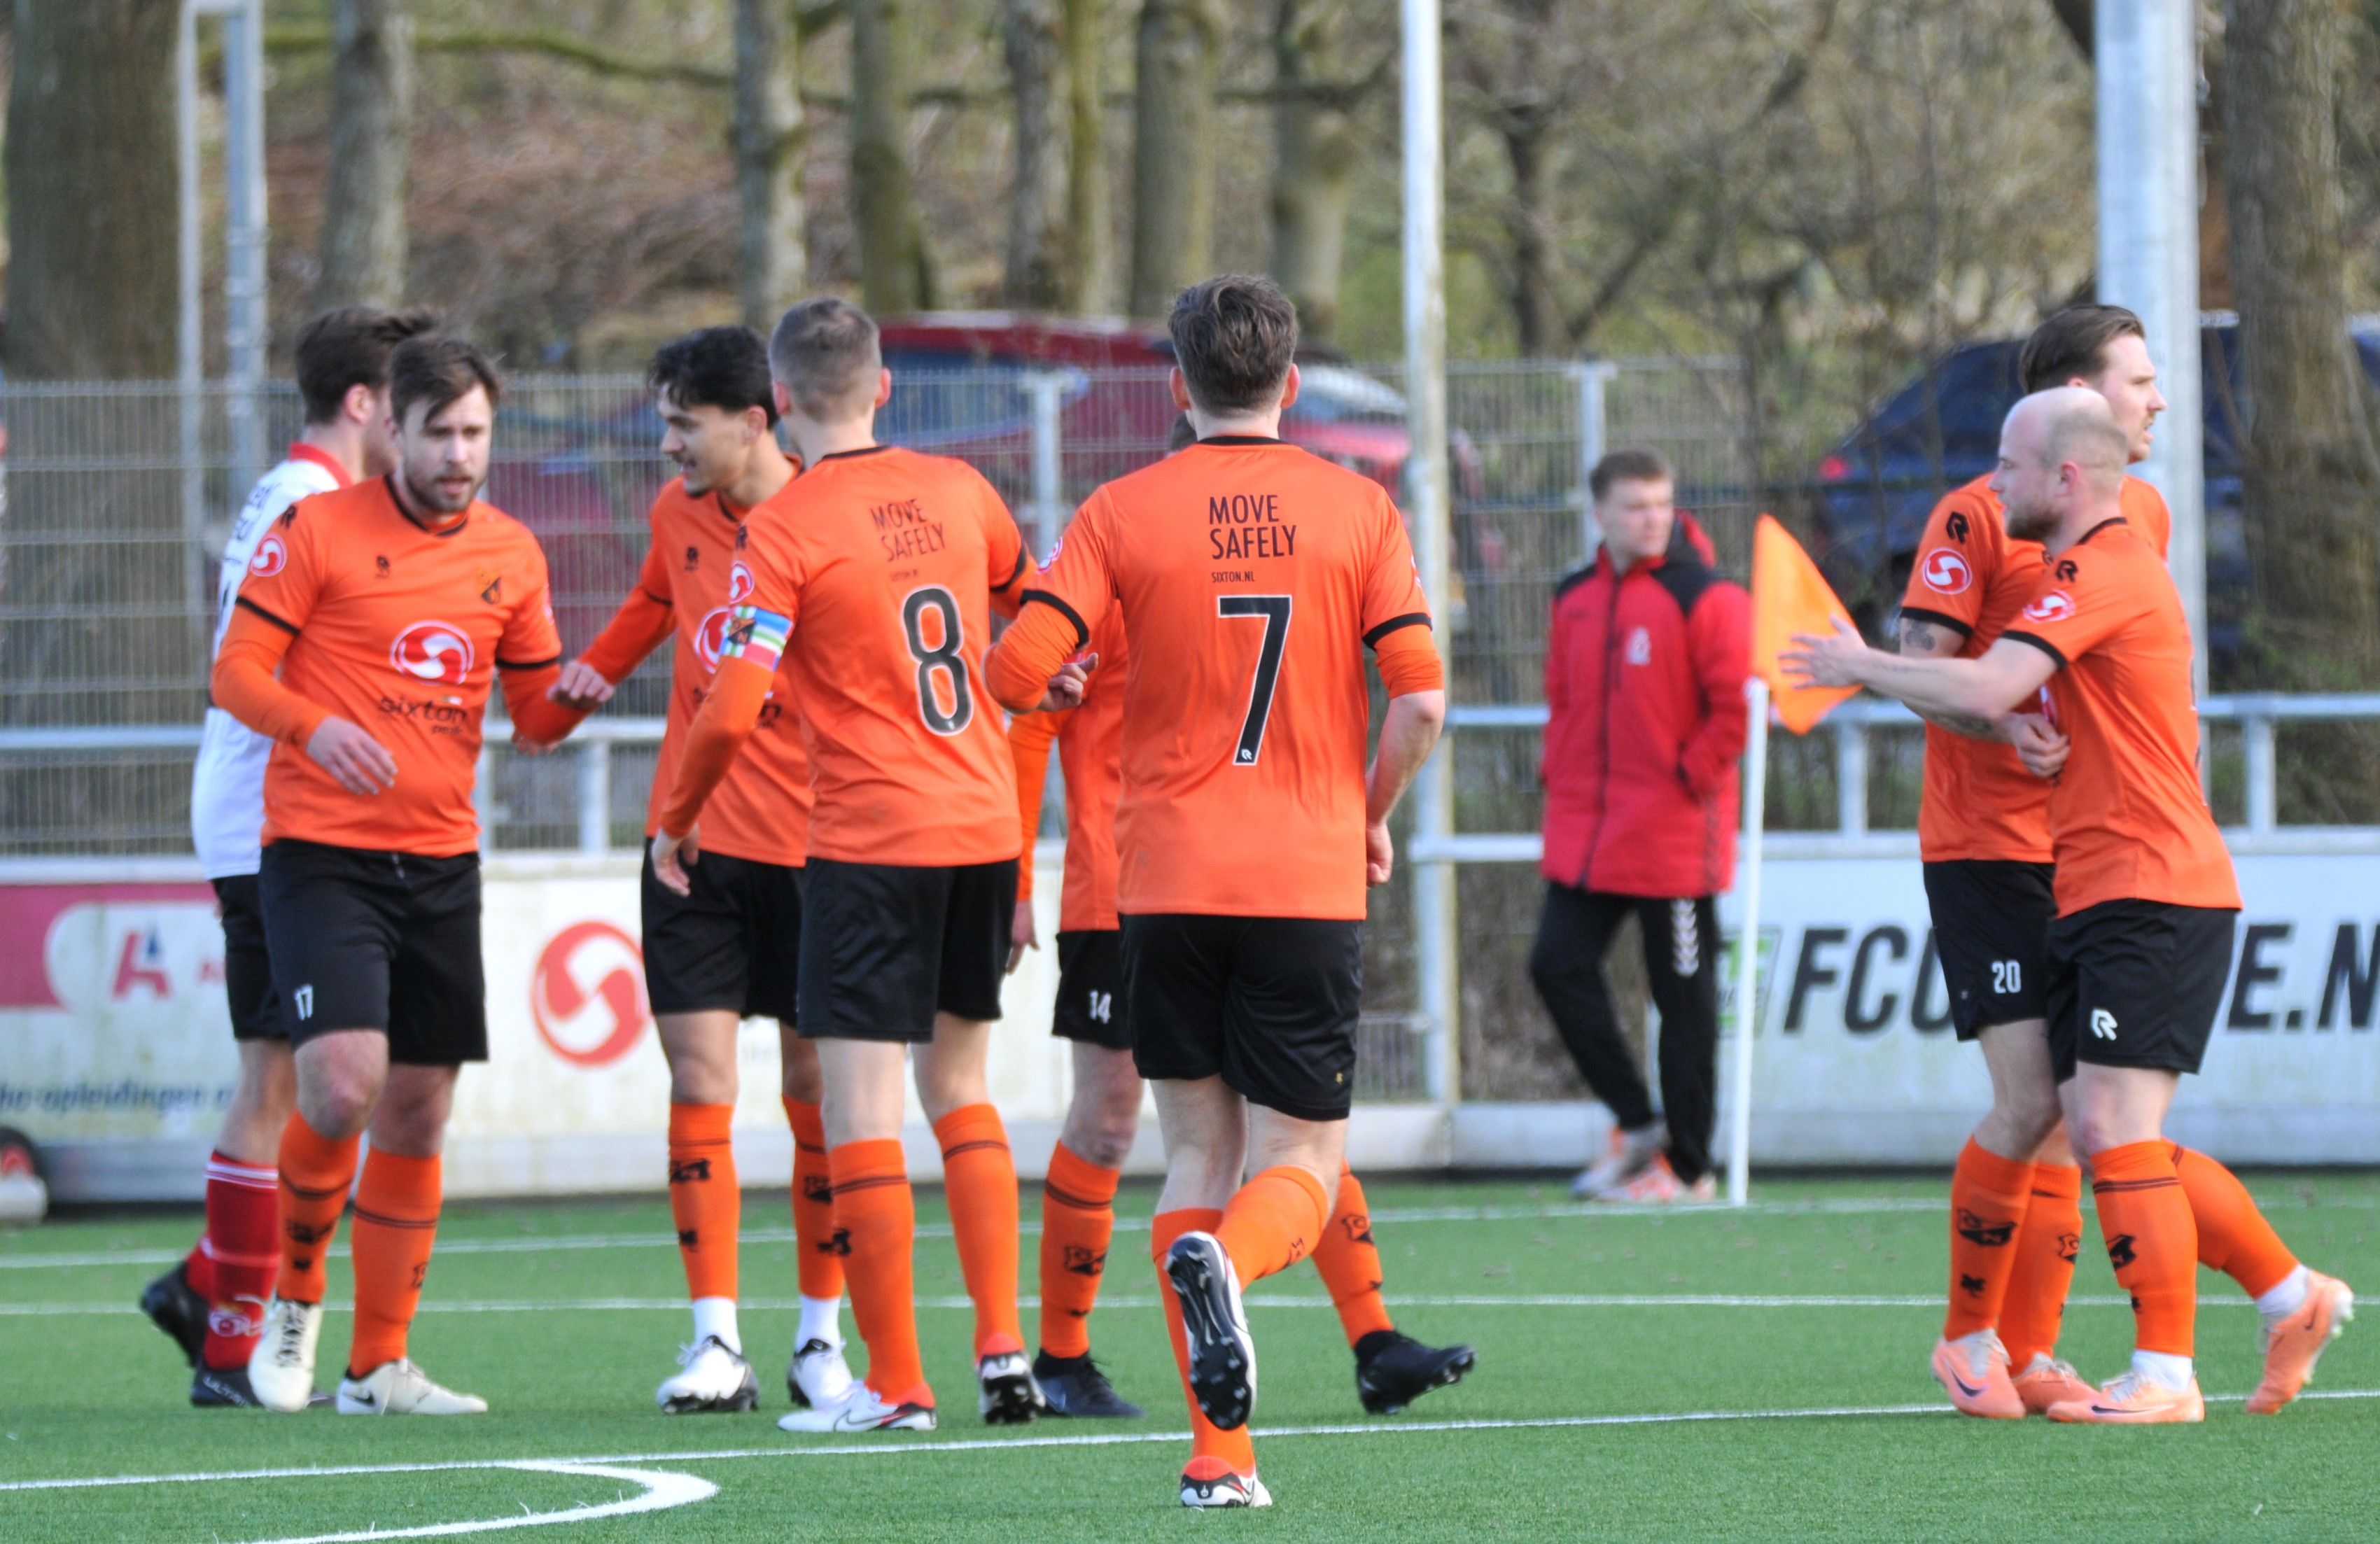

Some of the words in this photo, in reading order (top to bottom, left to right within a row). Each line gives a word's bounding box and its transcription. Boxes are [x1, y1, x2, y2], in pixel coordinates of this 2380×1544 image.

[869, 498, 927, 530] MOVE
[1209, 494, 1280, 525] MOVE
[881, 522, 946, 562] SAFELY
[1210, 525, 1297, 560] SAFELY
[1211, 570, 1255, 583] SIXTON.NL
[901, 584, 974, 736] 8
[1217, 595, 1292, 766] 7
[1991, 960, 2022, 994] 20
[294, 985, 313, 1020] 17
[1088, 990, 1111, 1024] 14
